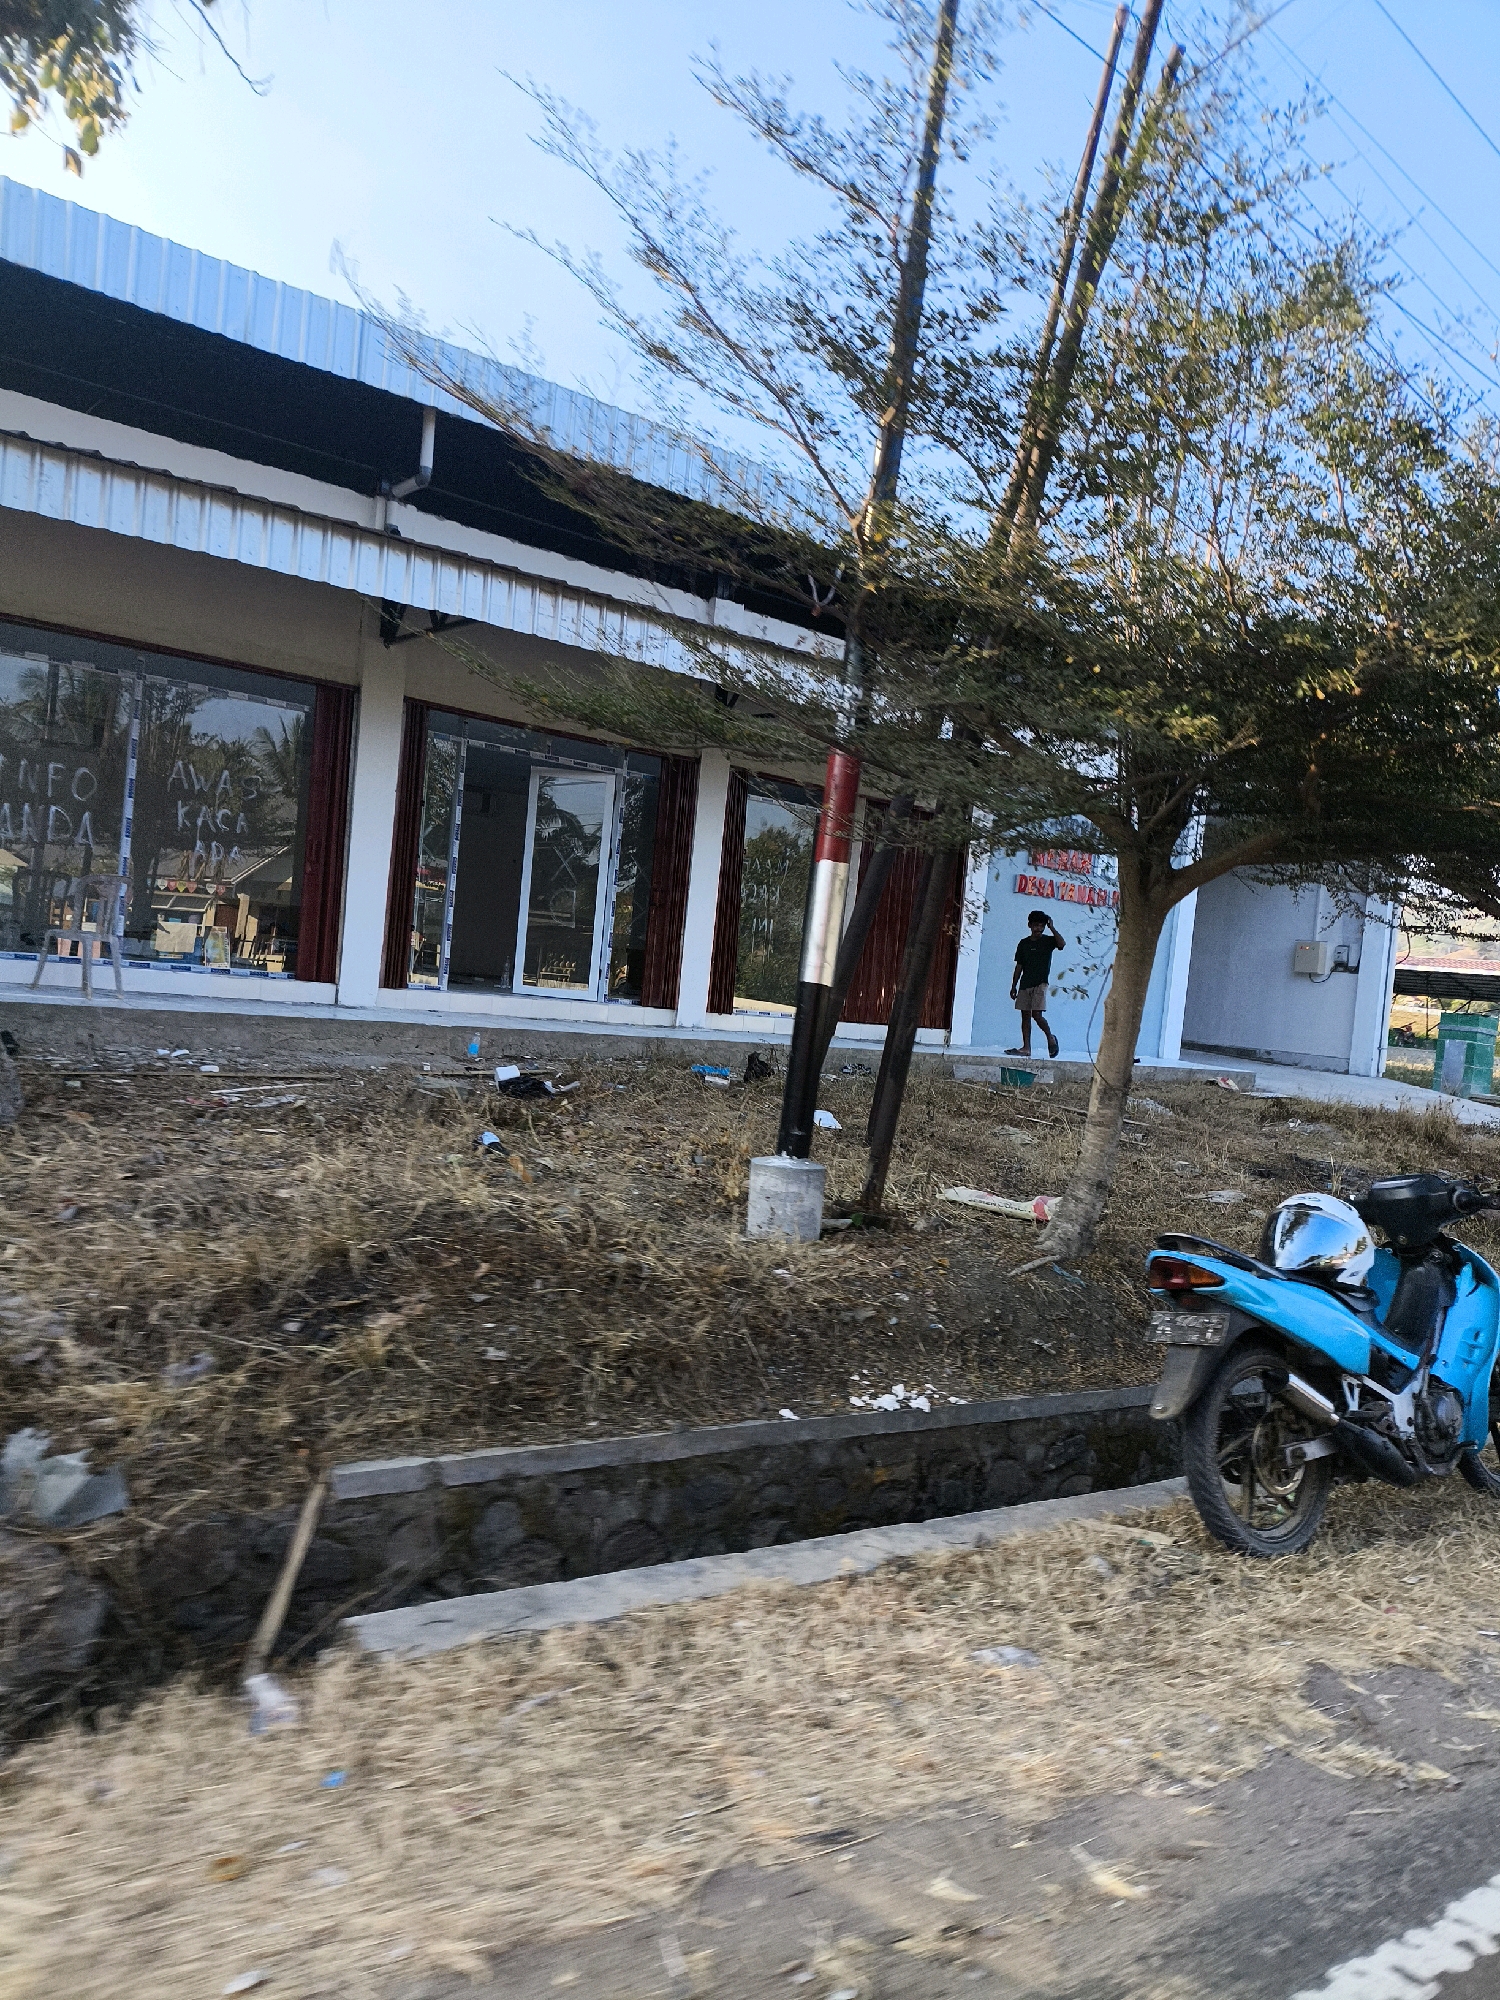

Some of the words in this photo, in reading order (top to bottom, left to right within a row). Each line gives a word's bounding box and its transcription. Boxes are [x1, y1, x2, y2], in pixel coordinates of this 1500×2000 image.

[167, 760, 263, 801] AWAS
[177, 800, 249, 834] KACA
[1016, 874, 1056, 898] DESA
